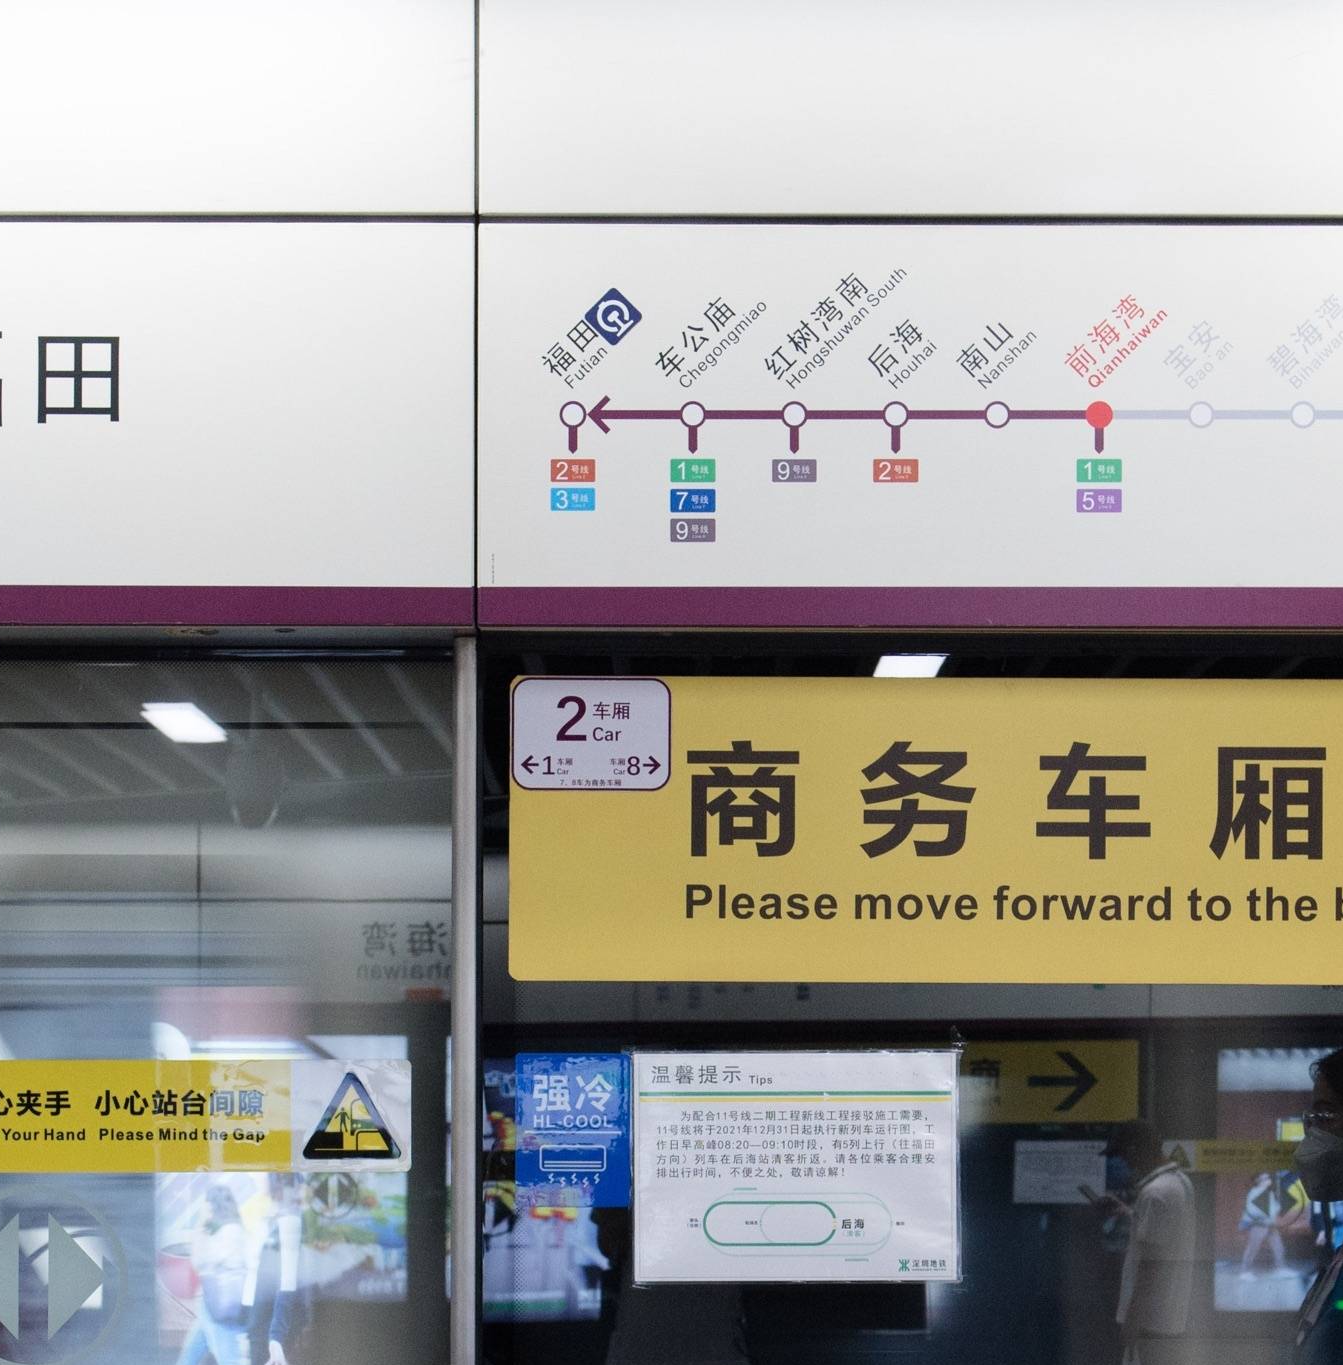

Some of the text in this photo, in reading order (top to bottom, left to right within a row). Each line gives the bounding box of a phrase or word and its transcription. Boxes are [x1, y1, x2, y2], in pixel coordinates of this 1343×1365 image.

[655, 297, 736, 378] 车公庙
[679, 300, 767, 389] Chegongmiao
[764, 271, 869, 381] 红树湾南
[785, 265, 909, 390] Hongshuwan South
[1064, 294, 1146, 379] 前海湾
[542, 319, 599, 377] 福田
[563, 346, 609, 389] Futian
[867, 318, 924, 379] 后海
[888, 339, 939, 390] Houhai
[956, 319, 1015, 379] 南山
[978, 330, 1038, 390] Nanshan
[1087, 308, 1168, 389] Qianhaiwan
[1162, 319, 1221, 379] 宝安
[556, 695, 587, 742] 2
[592, 701, 631, 721] 车厢
[592, 727, 622, 742] Car
[542, 755, 555, 776] 1
[556, 767, 569, 776] Car
[613, 768, 626, 776] Car
[627, 755, 641, 776] 8
[684, 883, 838, 921] Please
[855, 893, 978, 922] move
[993, 884, 1173, 922] forward
[1187, 888, 1232, 923] to
[1248, 886, 1319, 923] the
[533, 1074, 613, 1112] 强冷
[651, 1065, 742, 1085] 温馨提示
[748, 1074, 773, 1086] Tips
[95, 1089, 264, 1118] 小心站台间隙
[2, 1127, 39, 1142] Your
[43, 1127, 86, 1142] Hand
[99, 1127, 154, 1142] Please
[159, 1127, 198, 1142] Mind
[202, 1127, 229, 1142] the
[233, 1127, 266, 1145] Gap
[841, 1218, 865, 1230] 后海
[912, 1259, 947, 1269] 深圳地铁
